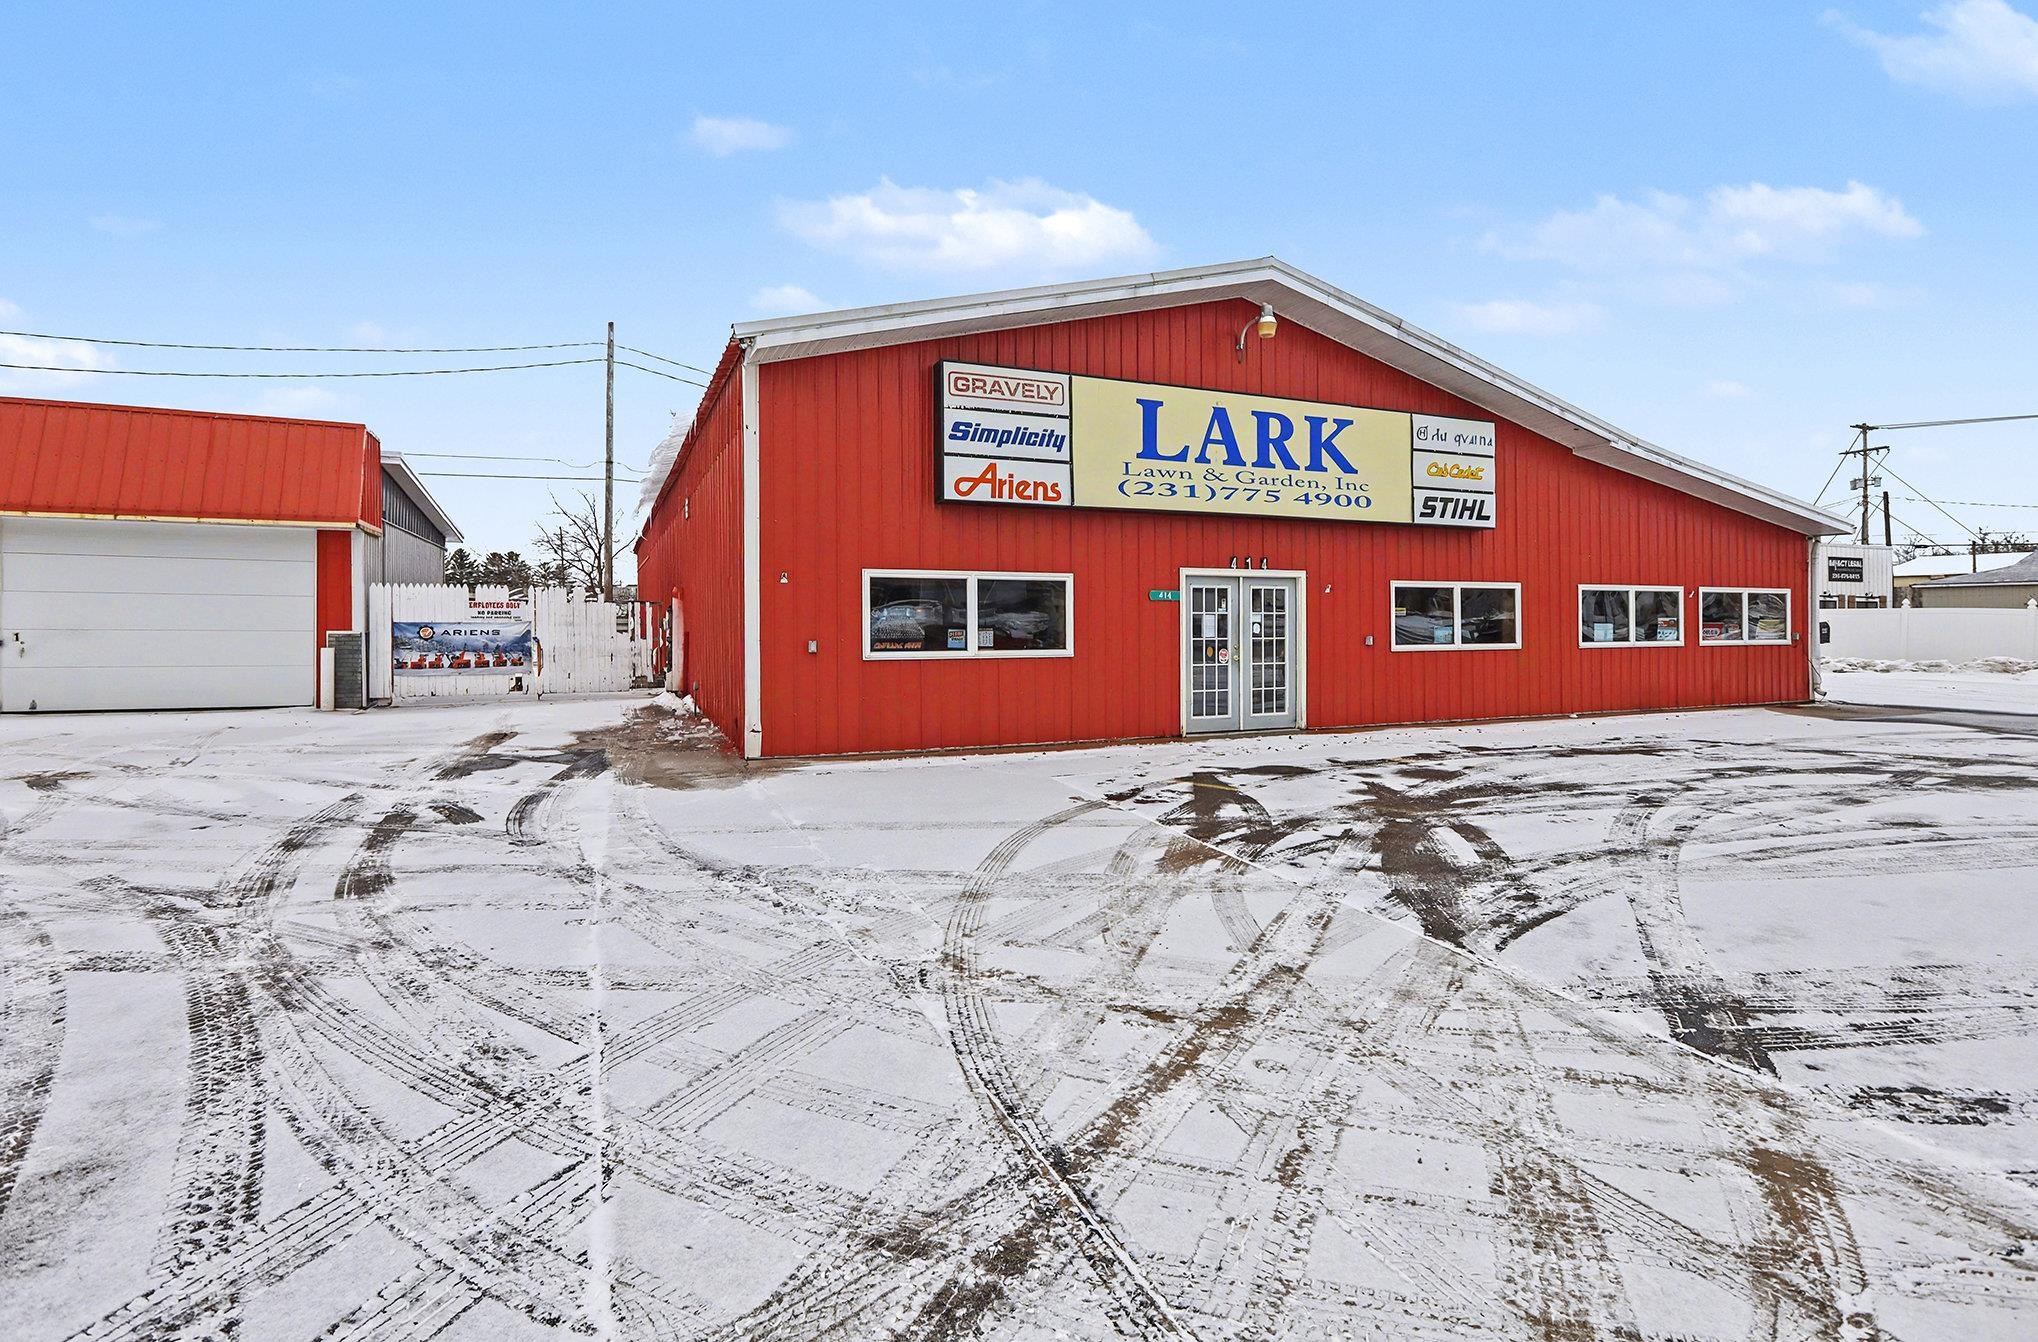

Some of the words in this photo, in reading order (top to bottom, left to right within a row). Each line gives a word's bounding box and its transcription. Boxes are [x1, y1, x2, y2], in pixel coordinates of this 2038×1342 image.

[953, 376, 1059, 401] GRAVELY
[948, 421, 1066, 452] Simplicity
[1136, 398, 1358, 474] LARK
[954, 462, 1062, 502] Ariens
[1122, 462, 1193, 480] Lawn
[1203, 468, 1228, 482] &
[1235, 471, 1327, 491] Garden,
[1335, 477, 1369, 492] Inc
[1293, 492, 1372, 508] 4900
[1419, 496, 1491, 521] STIHL
[1158, 591, 1172, 599] 414
